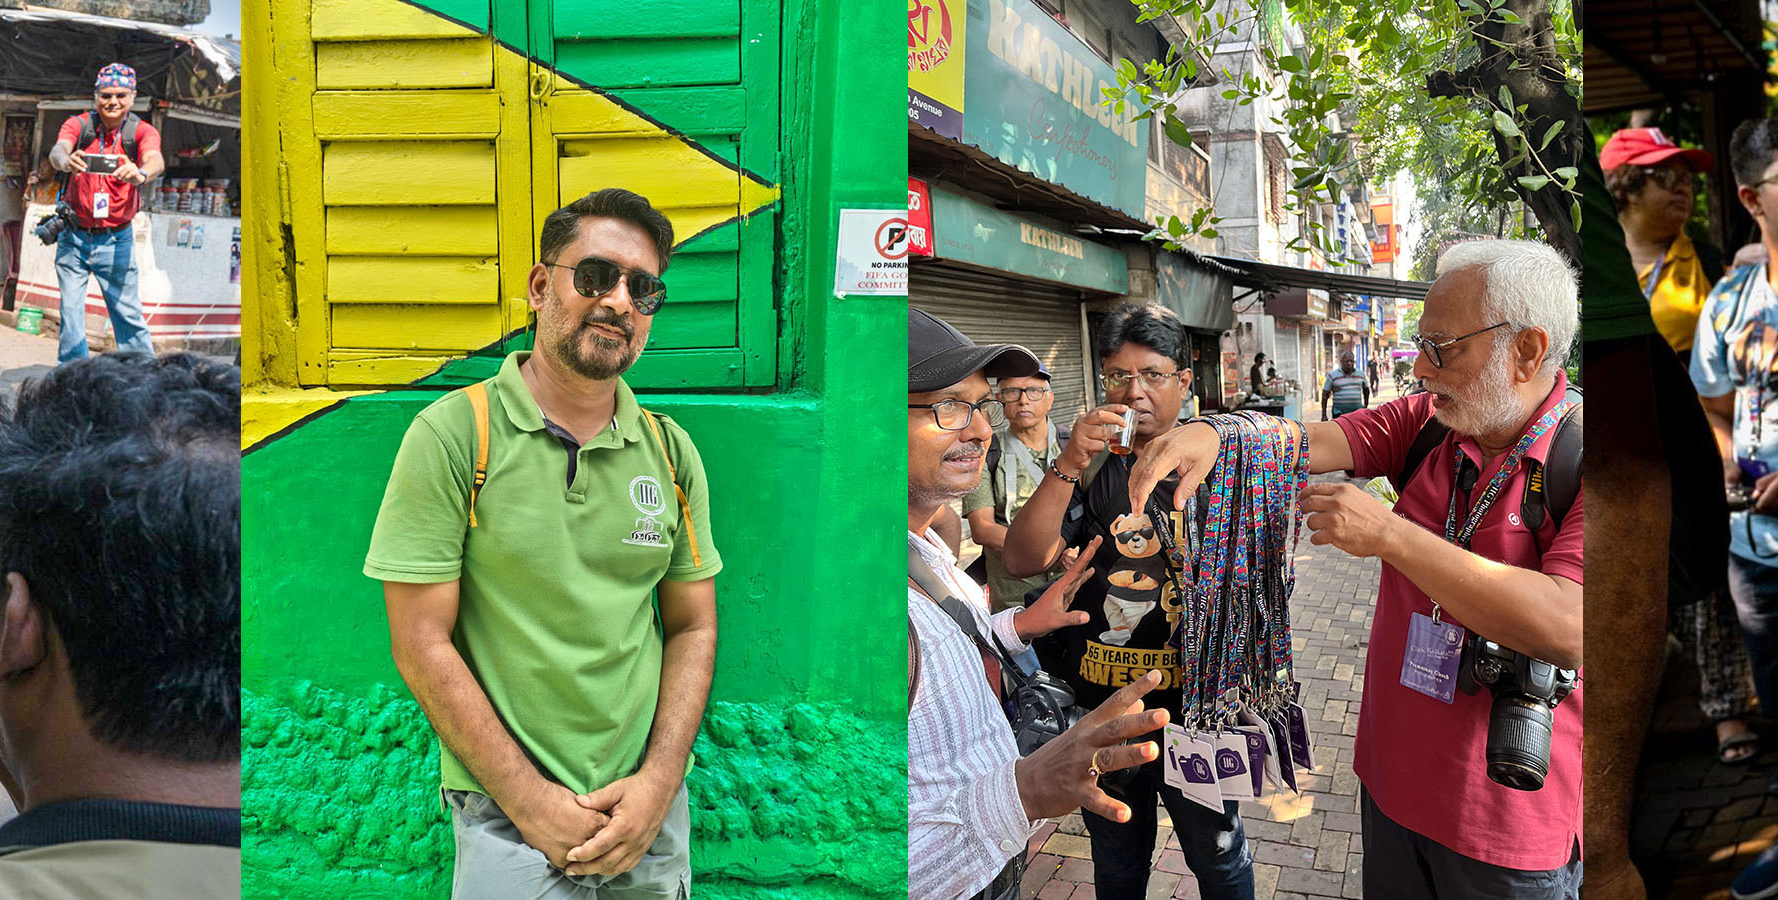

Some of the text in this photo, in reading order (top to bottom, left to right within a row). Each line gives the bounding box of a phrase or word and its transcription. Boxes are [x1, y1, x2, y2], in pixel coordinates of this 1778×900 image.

[987, 0, 1139, 148] KATHLEEN
[912, 95, 943, 118] Avenue
[1019, 221, 1084, 260] KATHLEEN
[1460, 498, 1494, 542] Photographer
[1187, 586, 1197, 639] Photographer
[1237, 588, 1249, 654] IIG Photographer
[1088, 645, 1099, 660] 65
[1102, 647, 1139, 665] YEARS
[1142, 652, 1159, 666] OF
